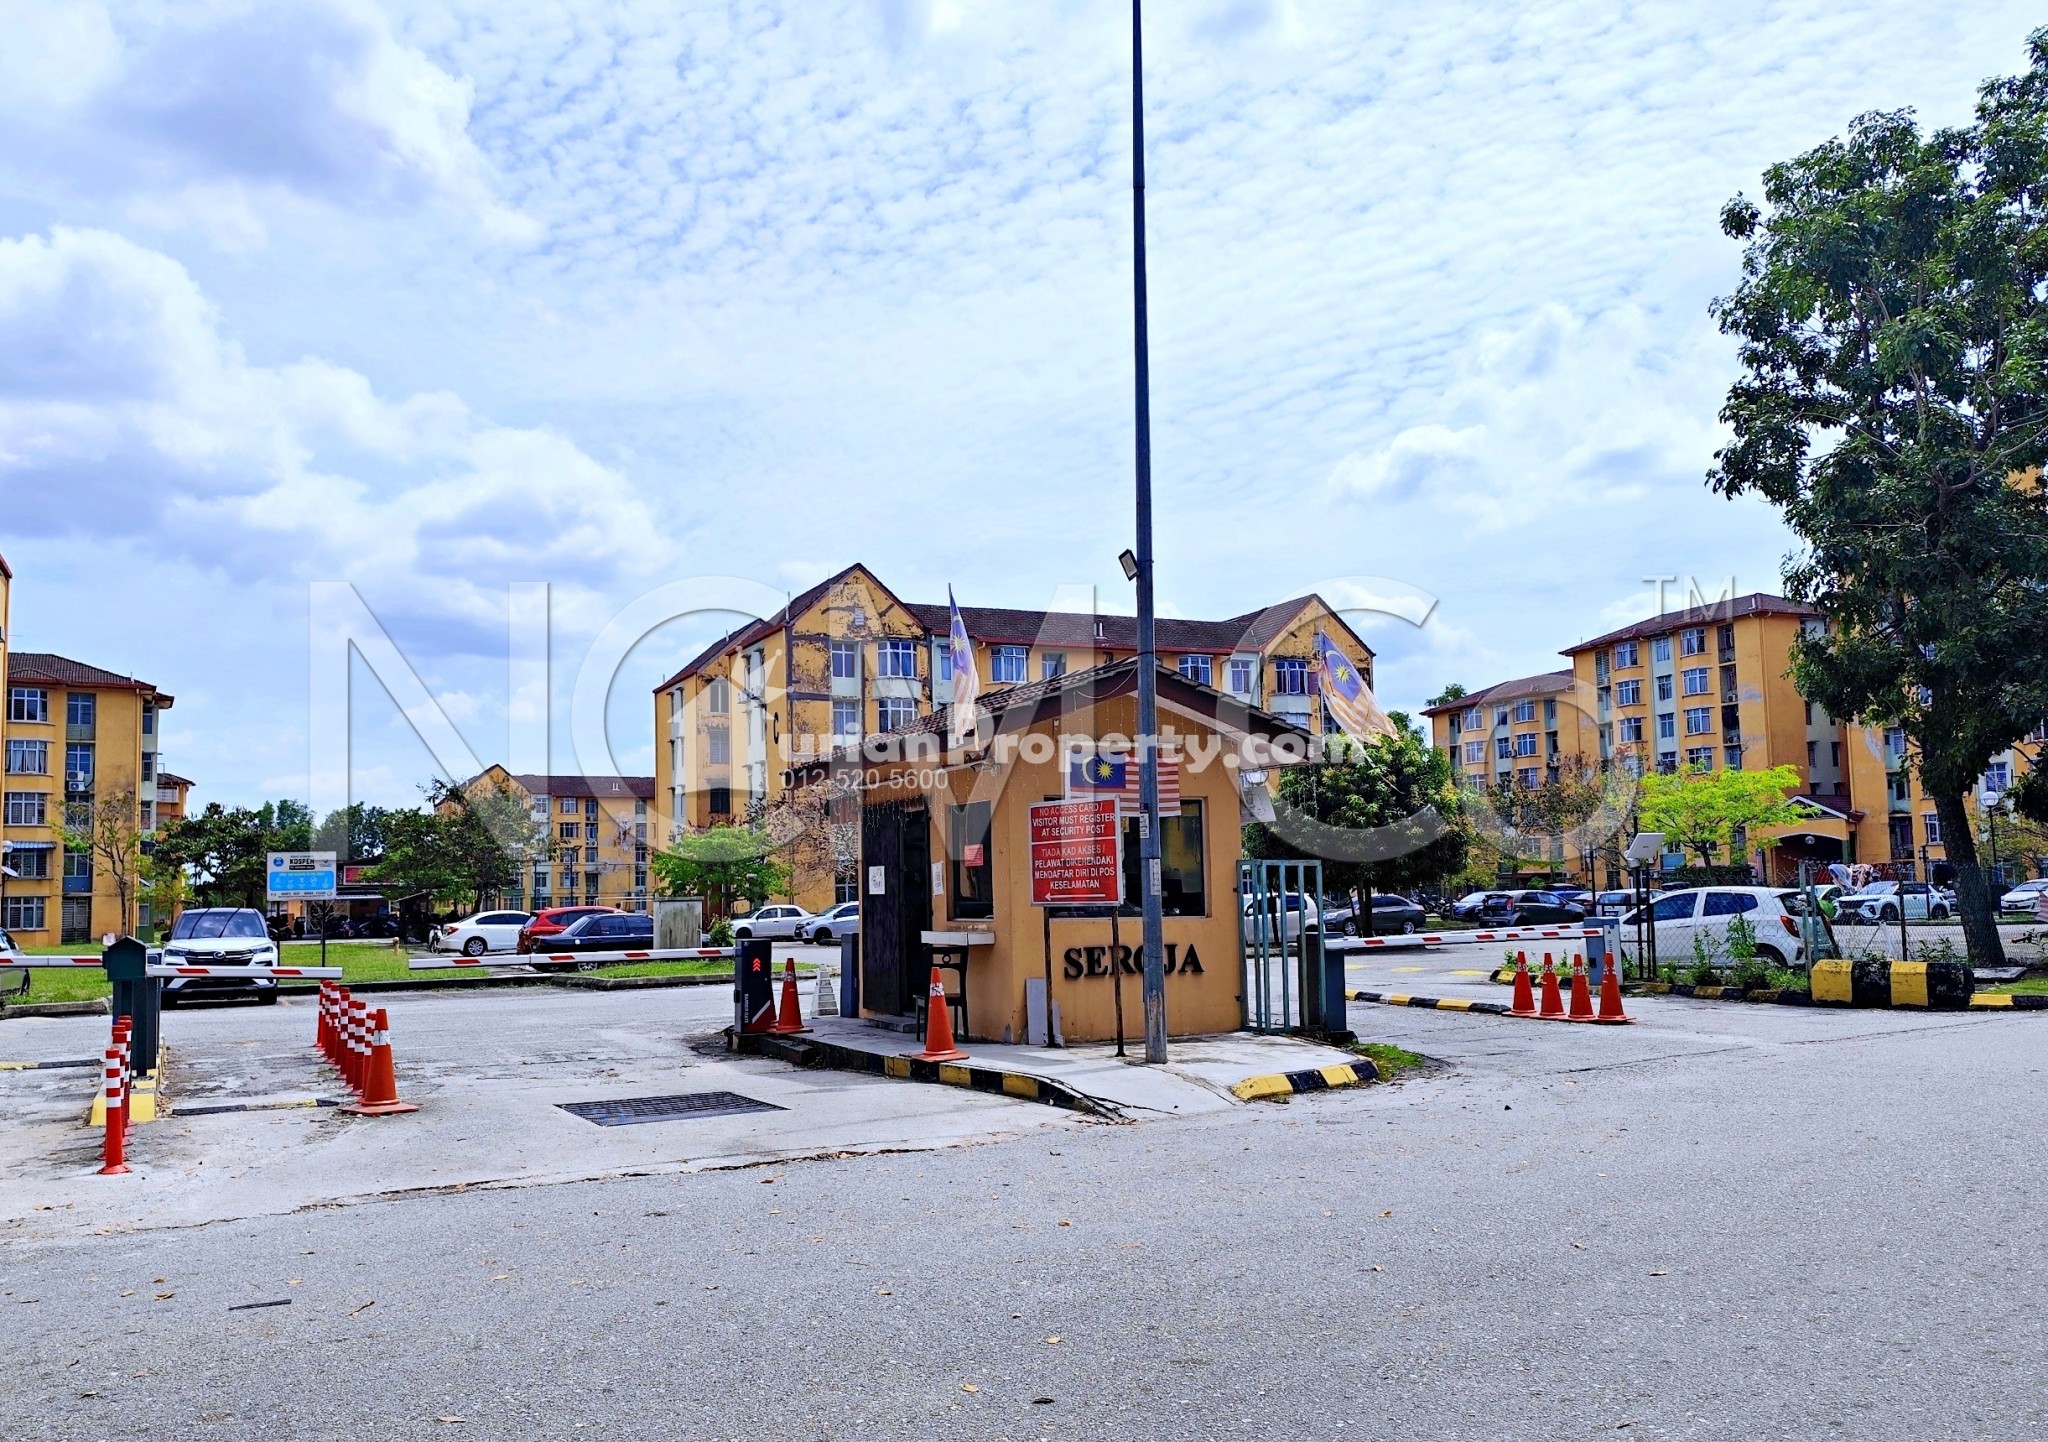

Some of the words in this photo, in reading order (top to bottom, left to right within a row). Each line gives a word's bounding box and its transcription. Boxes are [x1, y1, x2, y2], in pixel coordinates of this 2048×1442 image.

[1040, 808, 1049, 816] NO
[1050, 805, 1078, 814] ACCESS
[1079, 803, 1098, 812] CARD
[1032, 818, 1058, 827] VISITOR
[1060, 816, 1078, 825] MUST
[1080, 813, 1116, 823] REGISTER
[1042, 828, 1050, 836] AT
[1052, 826, 1085, 836] SECURITY
[1086, 824, 1105, 834] POST
[1042, 848, 1060, 857] TIADA
[1062, 846, 1076, 856] KAD
[1078, 845, 1101, 854] AKSES
[1035, 858, 1064, 868] PELAWAT
[1066, 856, 1114, 866] DIKEHENDAKI
[1035, 870, 1074, 880] MENDAFTAR
[1076, 868, 1090, 877] DIRI
[1090, 868, 1098, 876] DI
[1100, 867, 1114, 876] POS
[1050, 880, 1100, 890] KESELAMATAN
